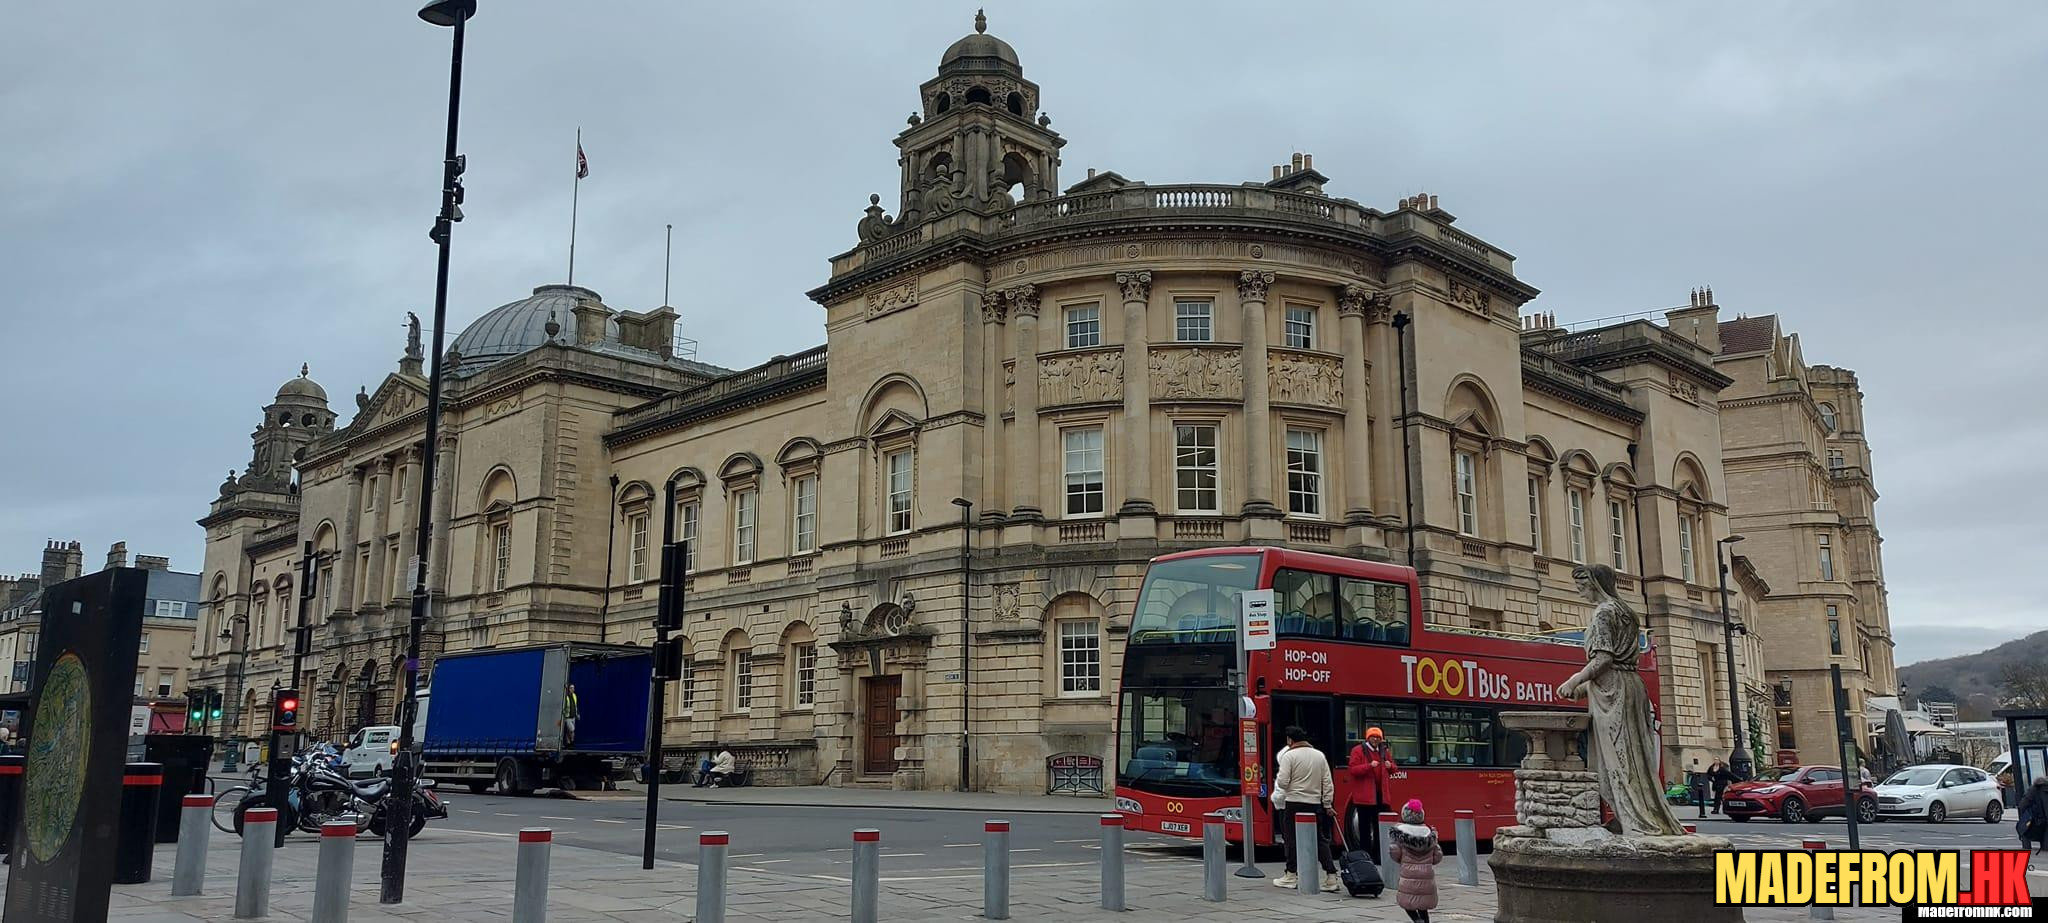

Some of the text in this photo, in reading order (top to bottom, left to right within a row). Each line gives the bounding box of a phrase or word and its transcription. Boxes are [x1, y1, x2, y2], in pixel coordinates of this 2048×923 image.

[1284, 649, 1327, 664] HOP-ON
[1285, 668, 1331, 683] HOP-OFF
[1516, 681, 1553, 702] BATH
